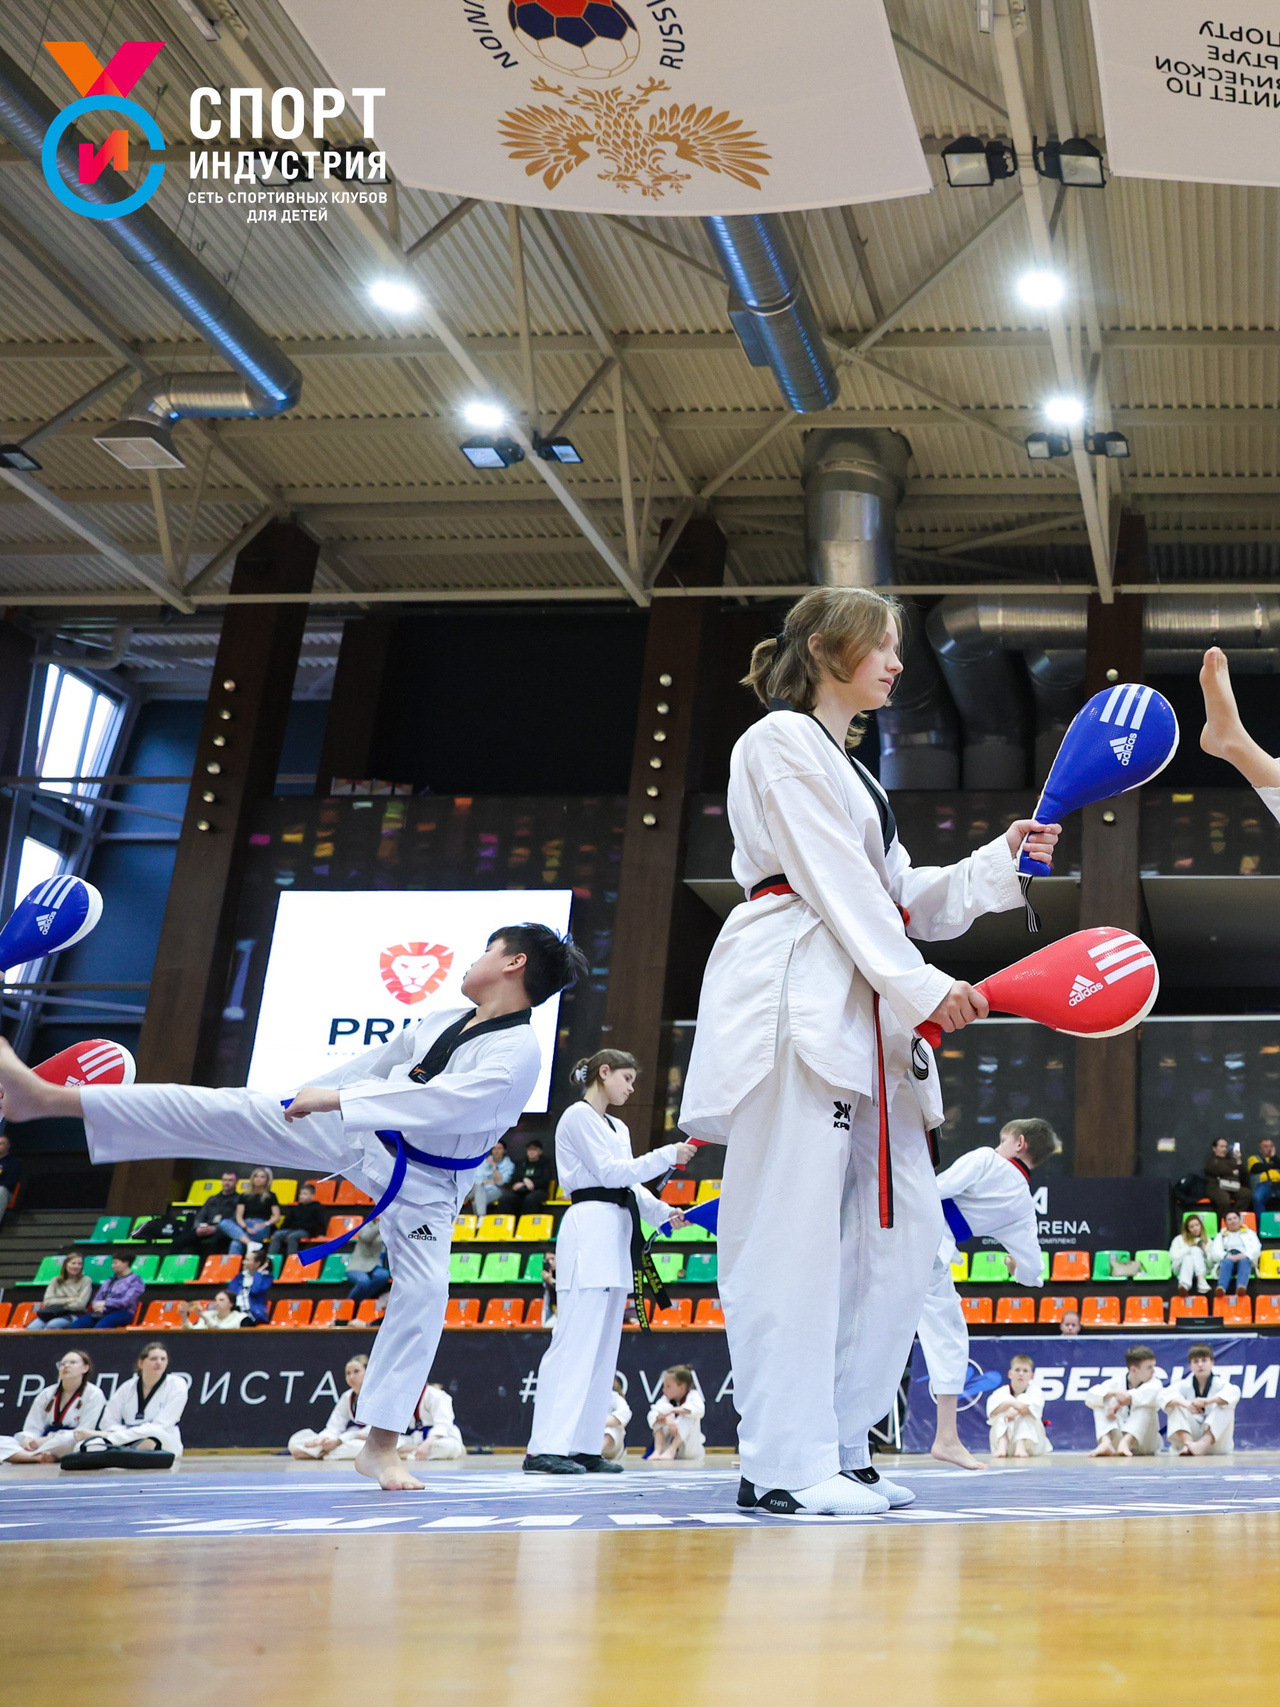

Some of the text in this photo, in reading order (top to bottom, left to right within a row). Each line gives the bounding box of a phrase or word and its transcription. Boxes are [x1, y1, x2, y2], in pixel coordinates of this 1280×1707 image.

[1166, 77, 1201, 97] ПО
[1121, 733, 1138, 766] adidas
[1068, 982, 1104, 1006] adidas
[407, 1233, 437, 1241] adidas
[1038, 1220, 1091, 1235] RENA
